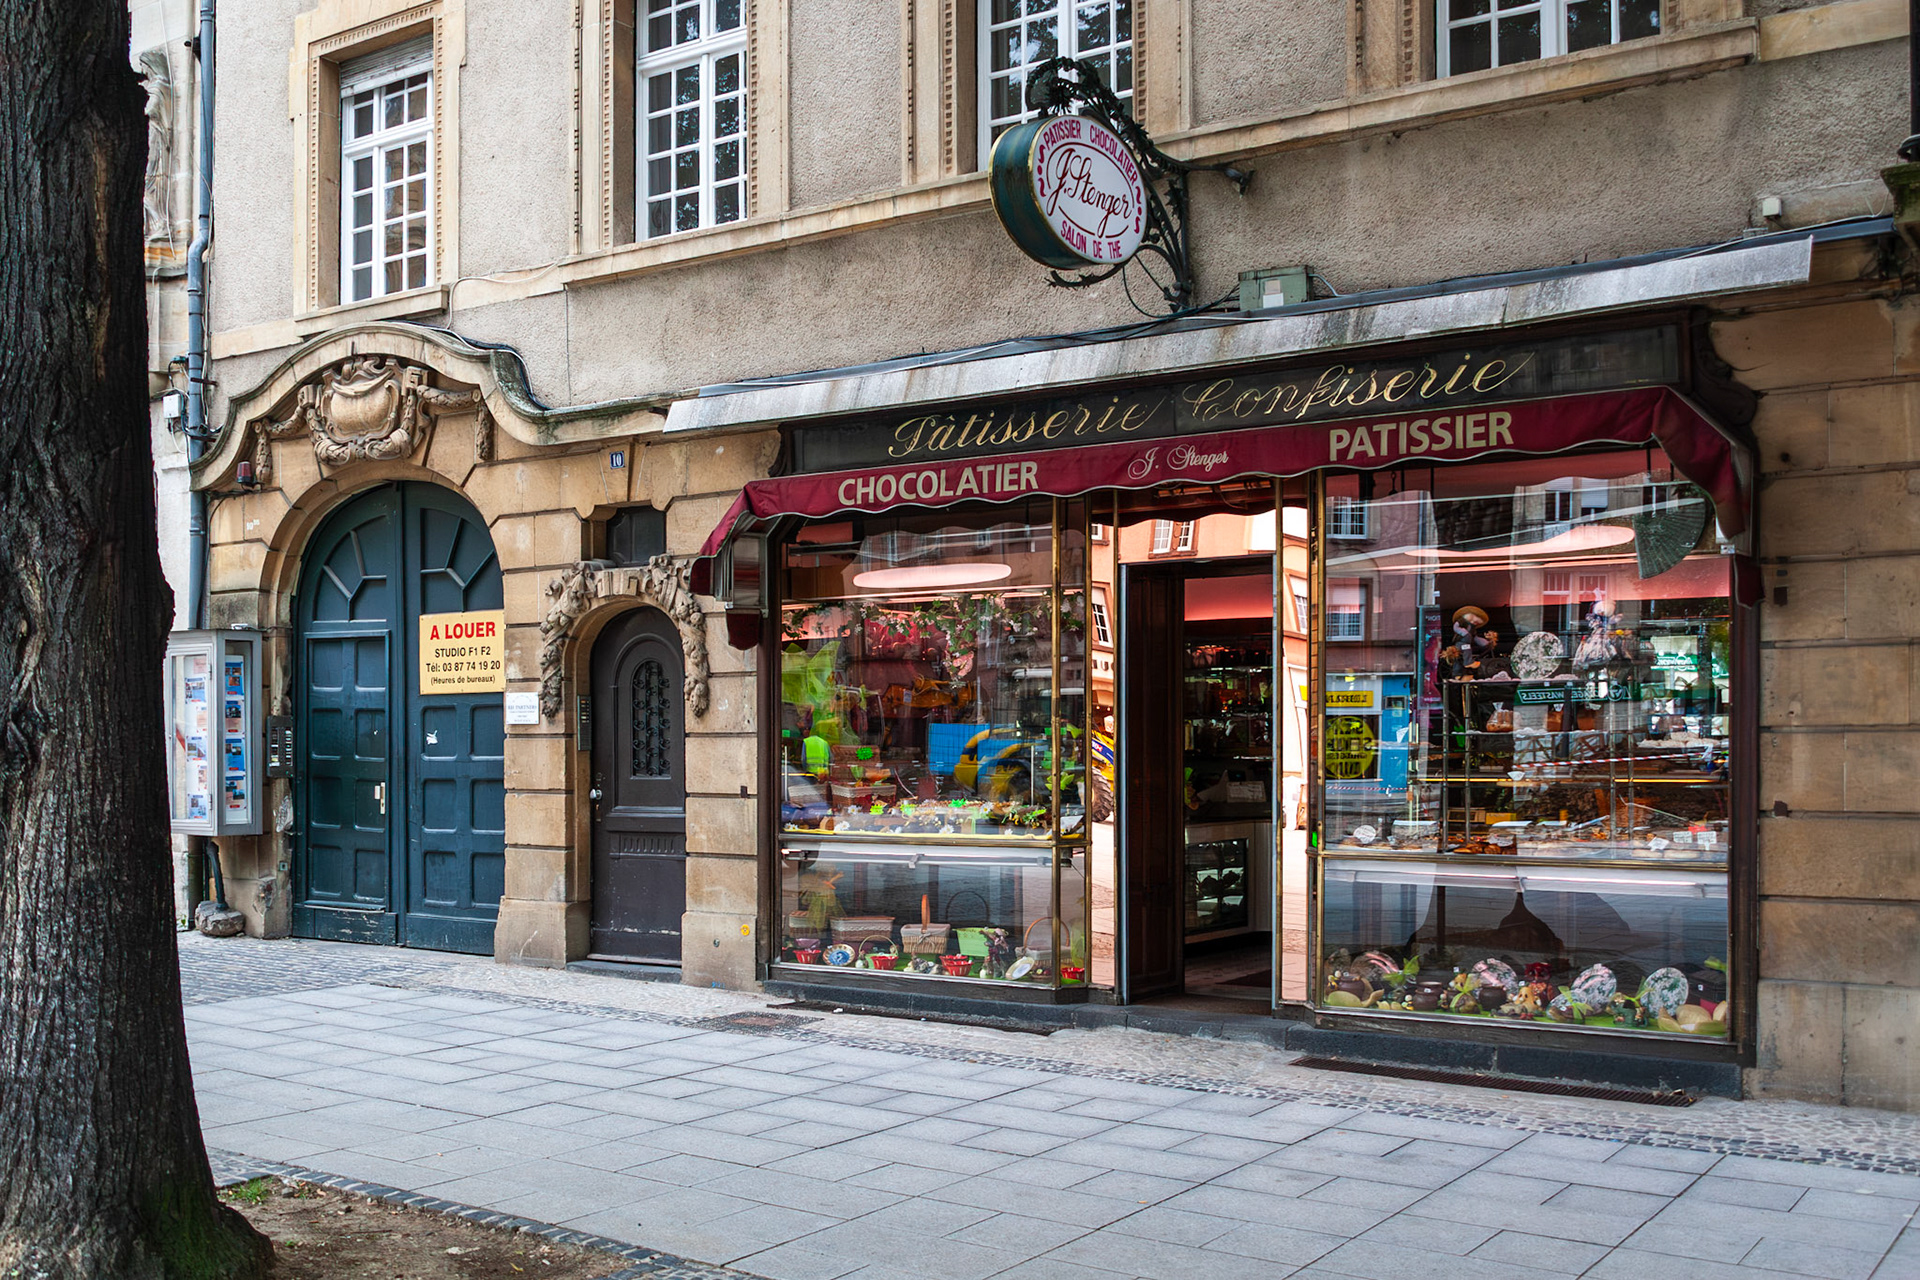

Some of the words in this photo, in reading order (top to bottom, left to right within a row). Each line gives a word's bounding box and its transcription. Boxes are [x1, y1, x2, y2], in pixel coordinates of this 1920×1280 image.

[1043, 119, 1081, 150] PATISSIER
[1089, 125, 1138, 187] CHOCOLATIER
[1060, 220, 1087, 254] SALON
[1092, 241, 1103, 259] DE
[1107, 240, 1123, 259] THE
[888, 395, 1167, 459] Pâtisserie
[1182, 351, 1535, 421] Confiserie
[612, 454, 623, 467] 10
[837, 460, 1039, 507] CHOCOLATIER
[1166, 443, 1230, 477] Stenger
[1329, 411, 1514, 463] PATISSIER
[430, 625, 440, 640] A
[444, 621, 496, 639] LOUER
[434, 647, 466, 658] STUDIO
[468, 647, 478, 657] F1
[480, 646, 491, 656] F2
[426, 662, 441, 673] Tél:
[442, 662, 452, 672] 03
[454, 662, 464, 671] 87
[466, 661, 476, 671] 74
[479, 661, 488, 670] 19
[490, 660, 501, 670] 20
[430, 676, 456, 686] (Heures
[456, 676, 466, 684] de
[467, 675, 496, 684] bureaux)
